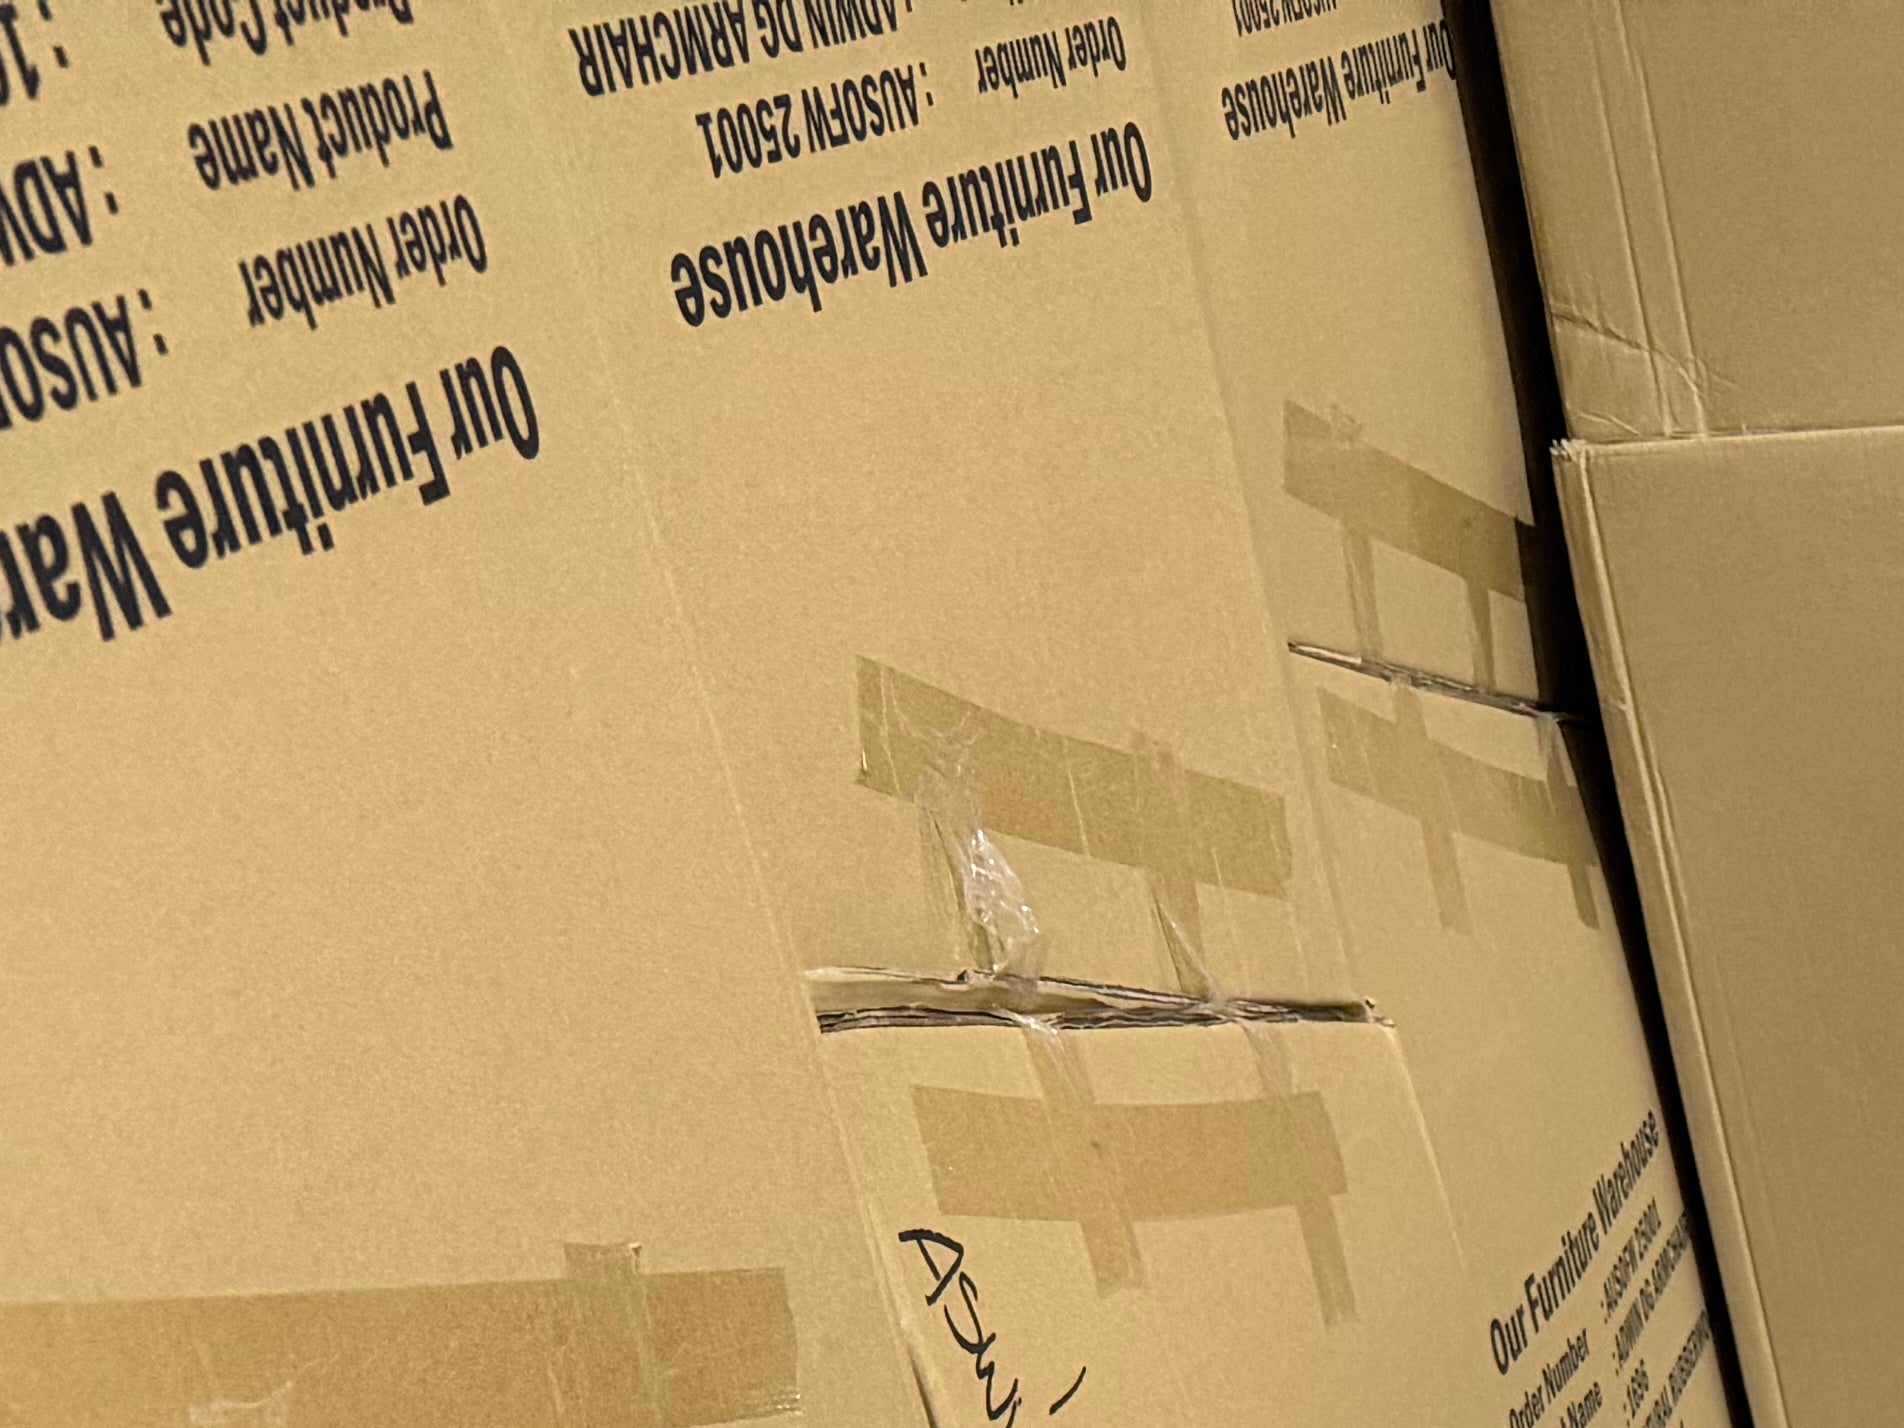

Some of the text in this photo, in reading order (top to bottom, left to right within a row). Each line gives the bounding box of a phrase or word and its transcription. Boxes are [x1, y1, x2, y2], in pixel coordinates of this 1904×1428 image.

[566, 0, 751, 98] ARMCHAIR
[750, 0, 804, 59] DG
[1219, 18, 1457, 142] Our Furniture Warehouse
[186, 101, 316, 192] Name
[299, 69, 454, 180] Product
[693, 14, 1127, 179] Order Number AUSOFW 25001
[669, 120, 1153, 328] Our Furniture Warehouse
[0, 192, 488, 431] Order Number AUSO
[0, 344, 540, 642] Our Furniture War
[1490, 1304, 1527, 1375] Our
[1524, 1212, 1598, 1333] Furniture
[1592, 1110, 1657, 1234] Warehouse
[1542, 1328, 1589, 1403] Number
